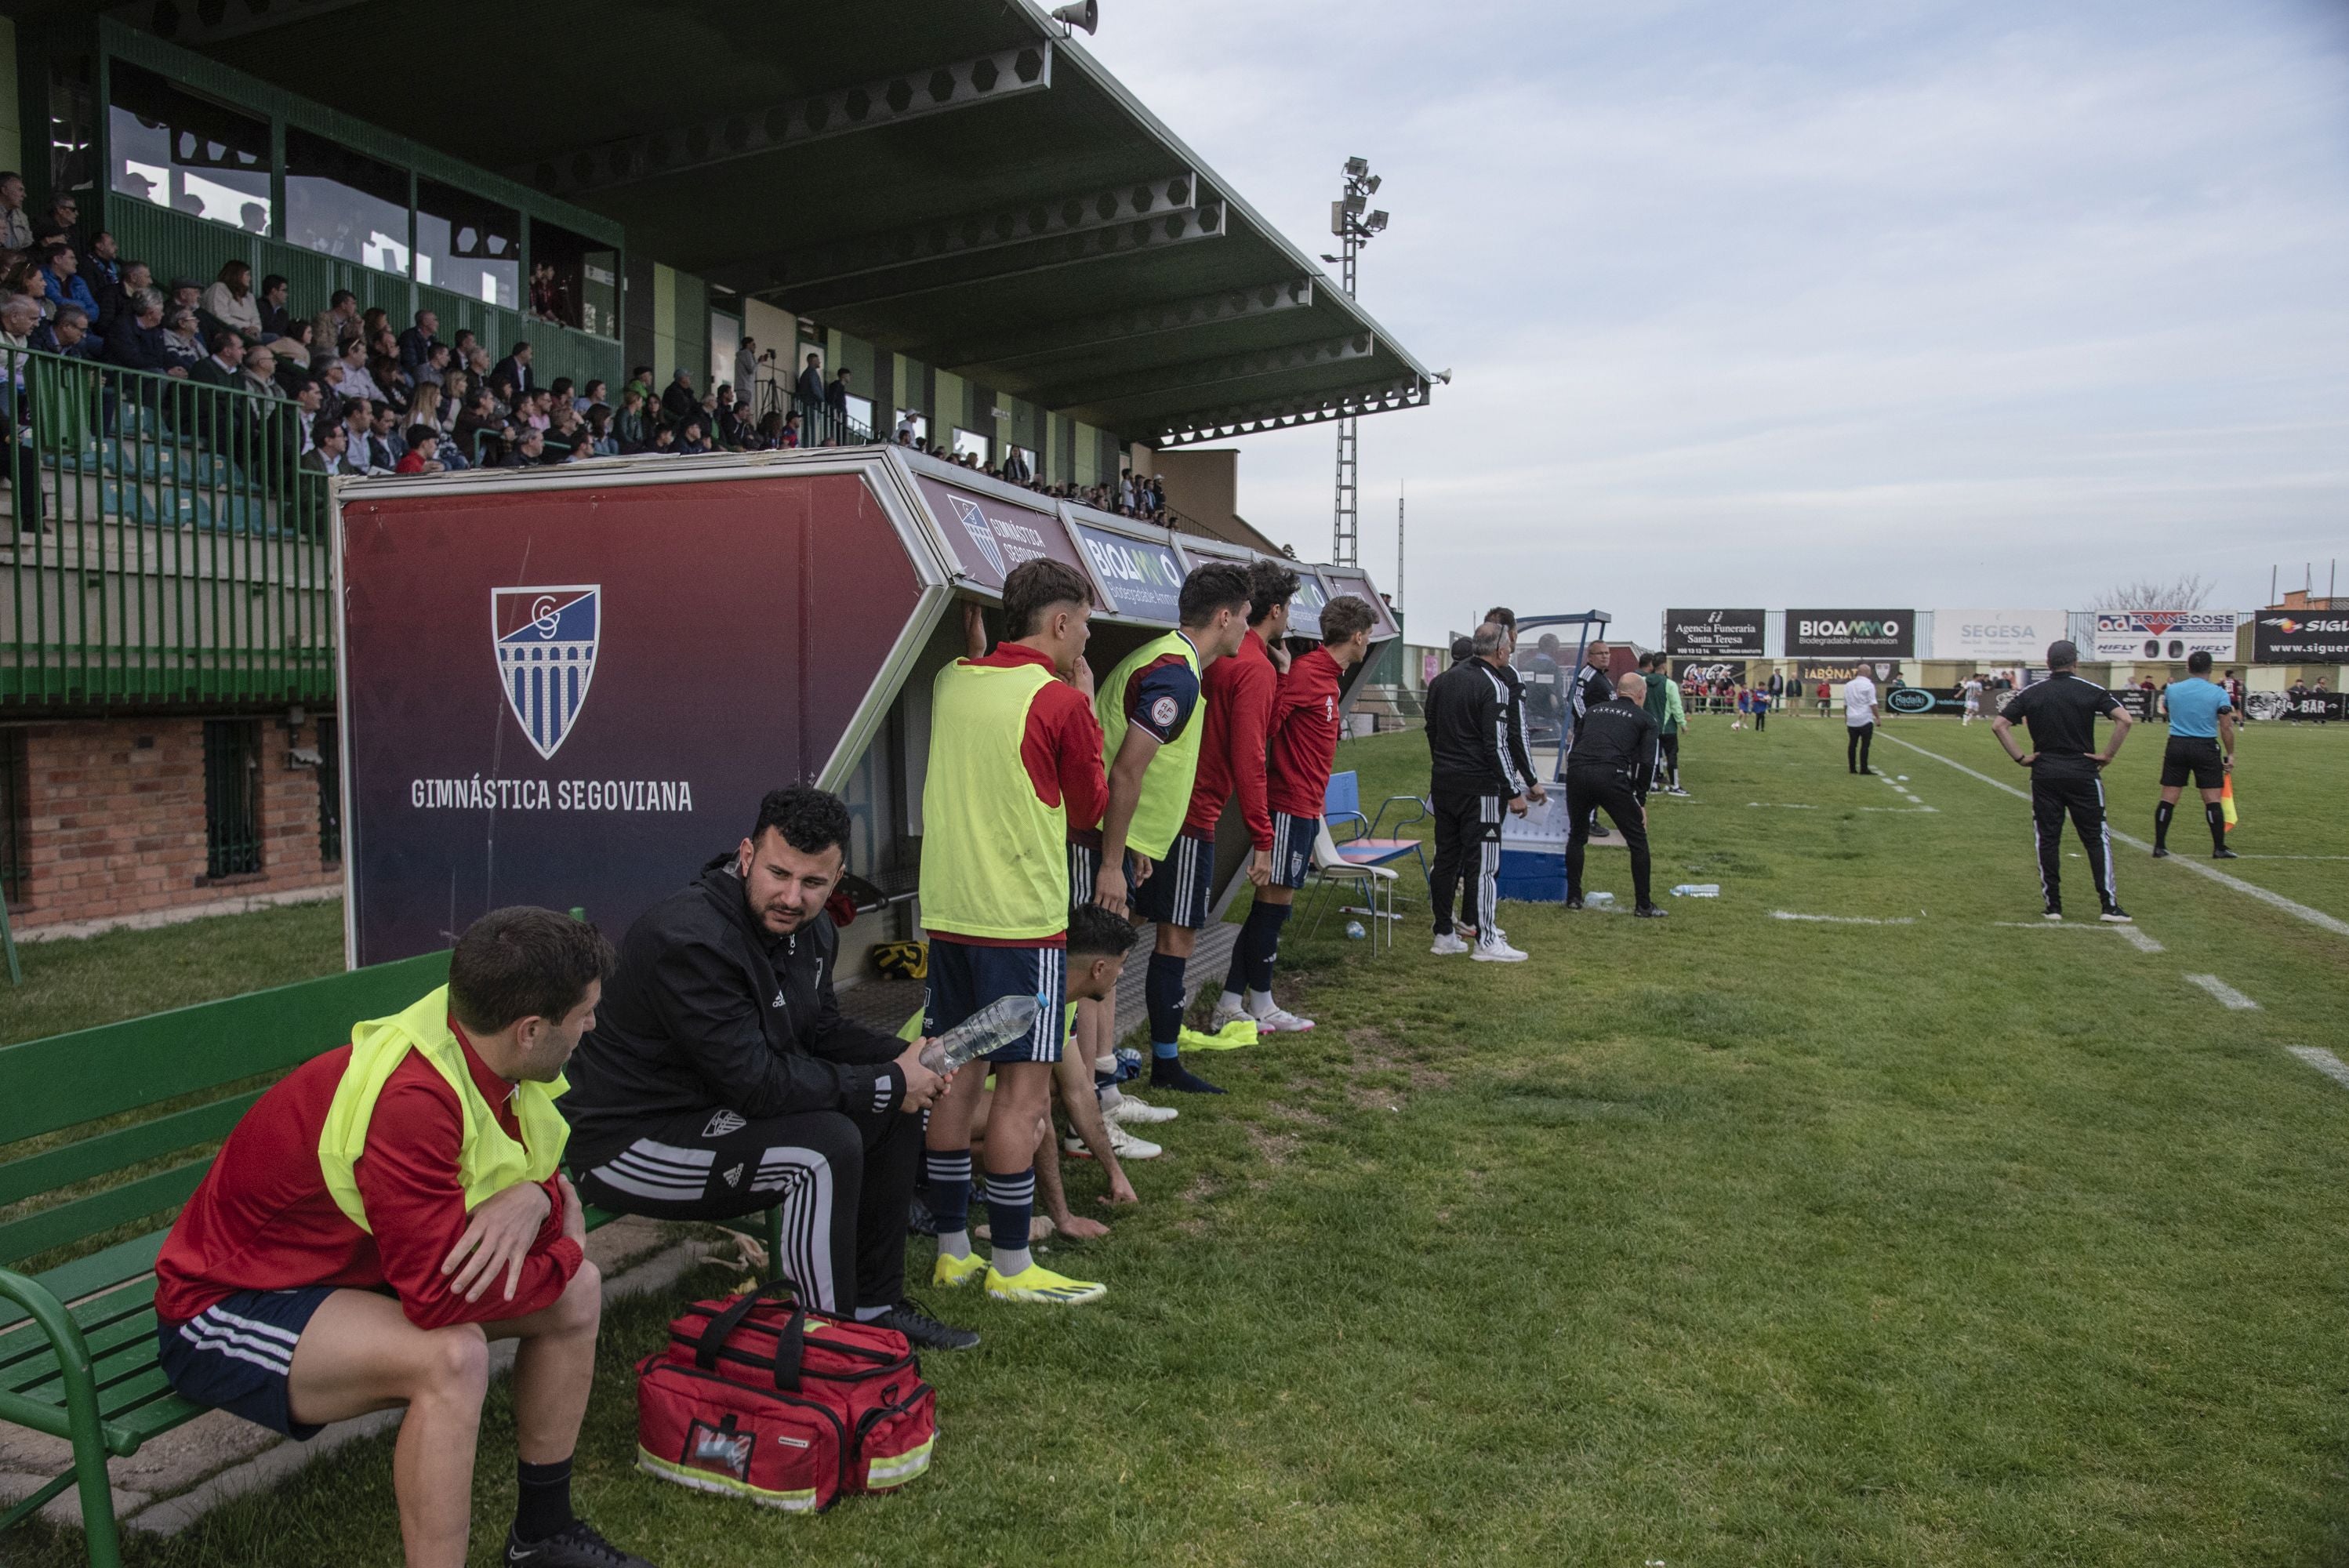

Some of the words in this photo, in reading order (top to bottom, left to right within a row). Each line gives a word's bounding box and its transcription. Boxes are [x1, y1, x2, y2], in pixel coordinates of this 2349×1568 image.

[989, 517, 1046, 548] GIMNÁSTICA
[2132, 615, 2234, 624] TRANSCOSE
[1676, 623, 1712, 634] Agencia
[1713, 623, 1755, 633] Funeraria
[1799, 620, 1899, 637] BIOAMMO
[1962, 625, 2035, 638] SEGESA
[1687, 634, 1712, 644] Santa
[1713, 634, 1743, 644] Teresa
[1799, 637, 1851, 646] Biodegradable
[1805, 666, 1858, 680] ¡ABÓNAT
[2300, 699, 2325, 713] BAR
[411, 771, 552, 809] GIMNÁSTICA
[557, 779, 693, 811] SEGOVIANA
